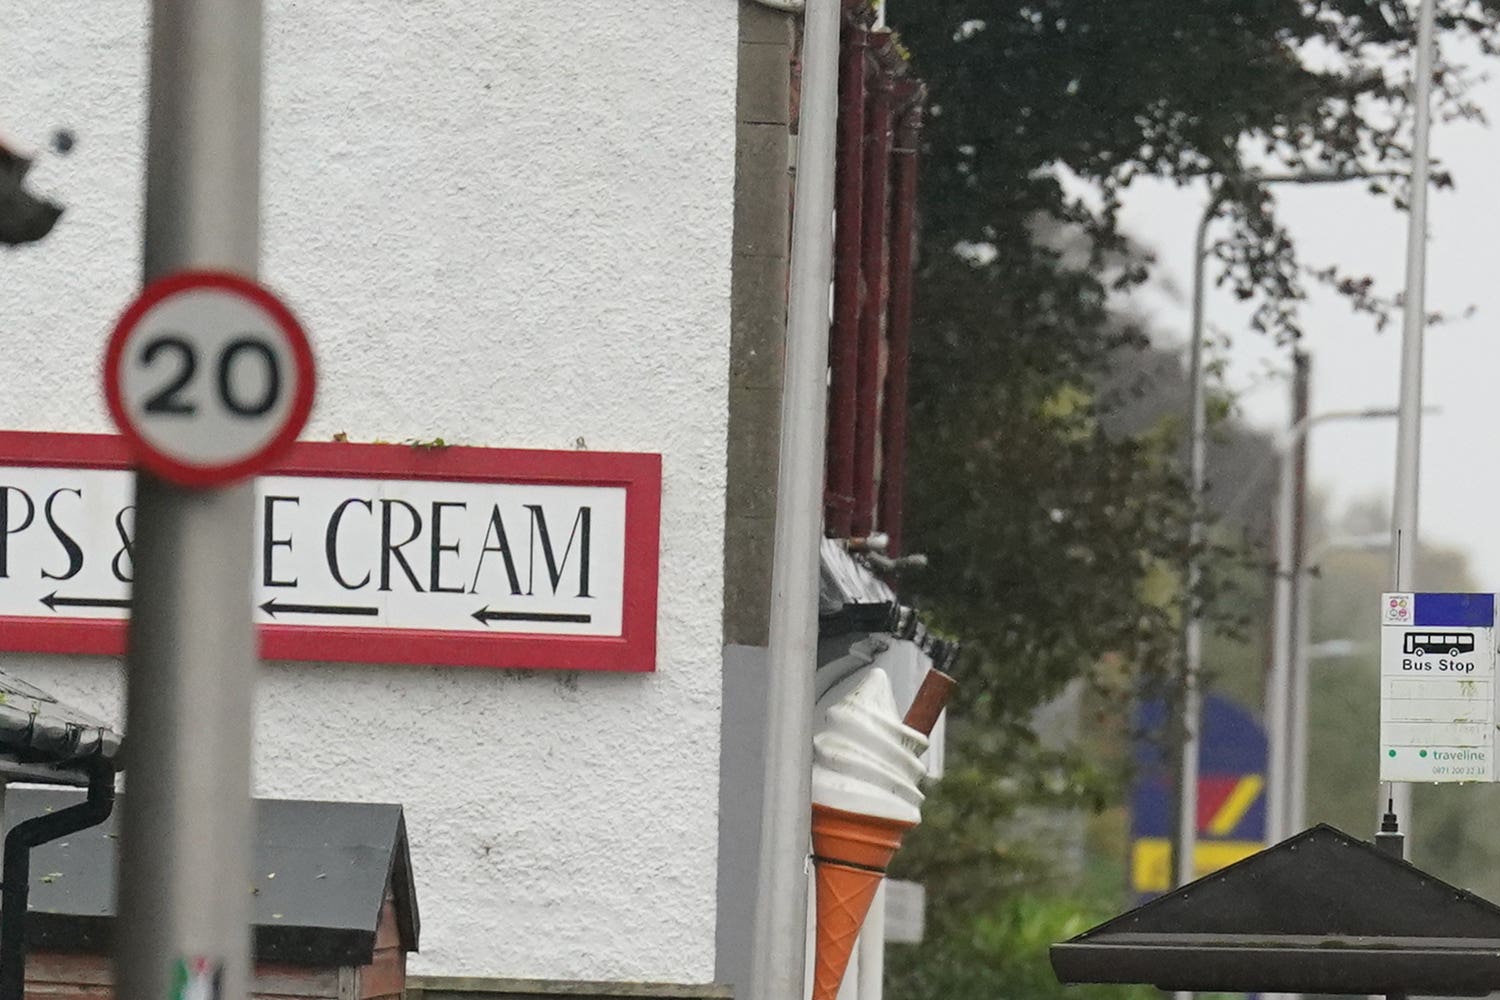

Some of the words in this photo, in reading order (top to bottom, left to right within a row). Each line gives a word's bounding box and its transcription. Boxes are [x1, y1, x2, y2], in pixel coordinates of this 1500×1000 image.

[140, 335, 281, 418] 20
[325, 498, 596, 598] CREAM
[1402, 659, 1432, 671] Bus
[1439, 659, 1475, 674] Stop
[1433, 750, 1485, 760] traveline
